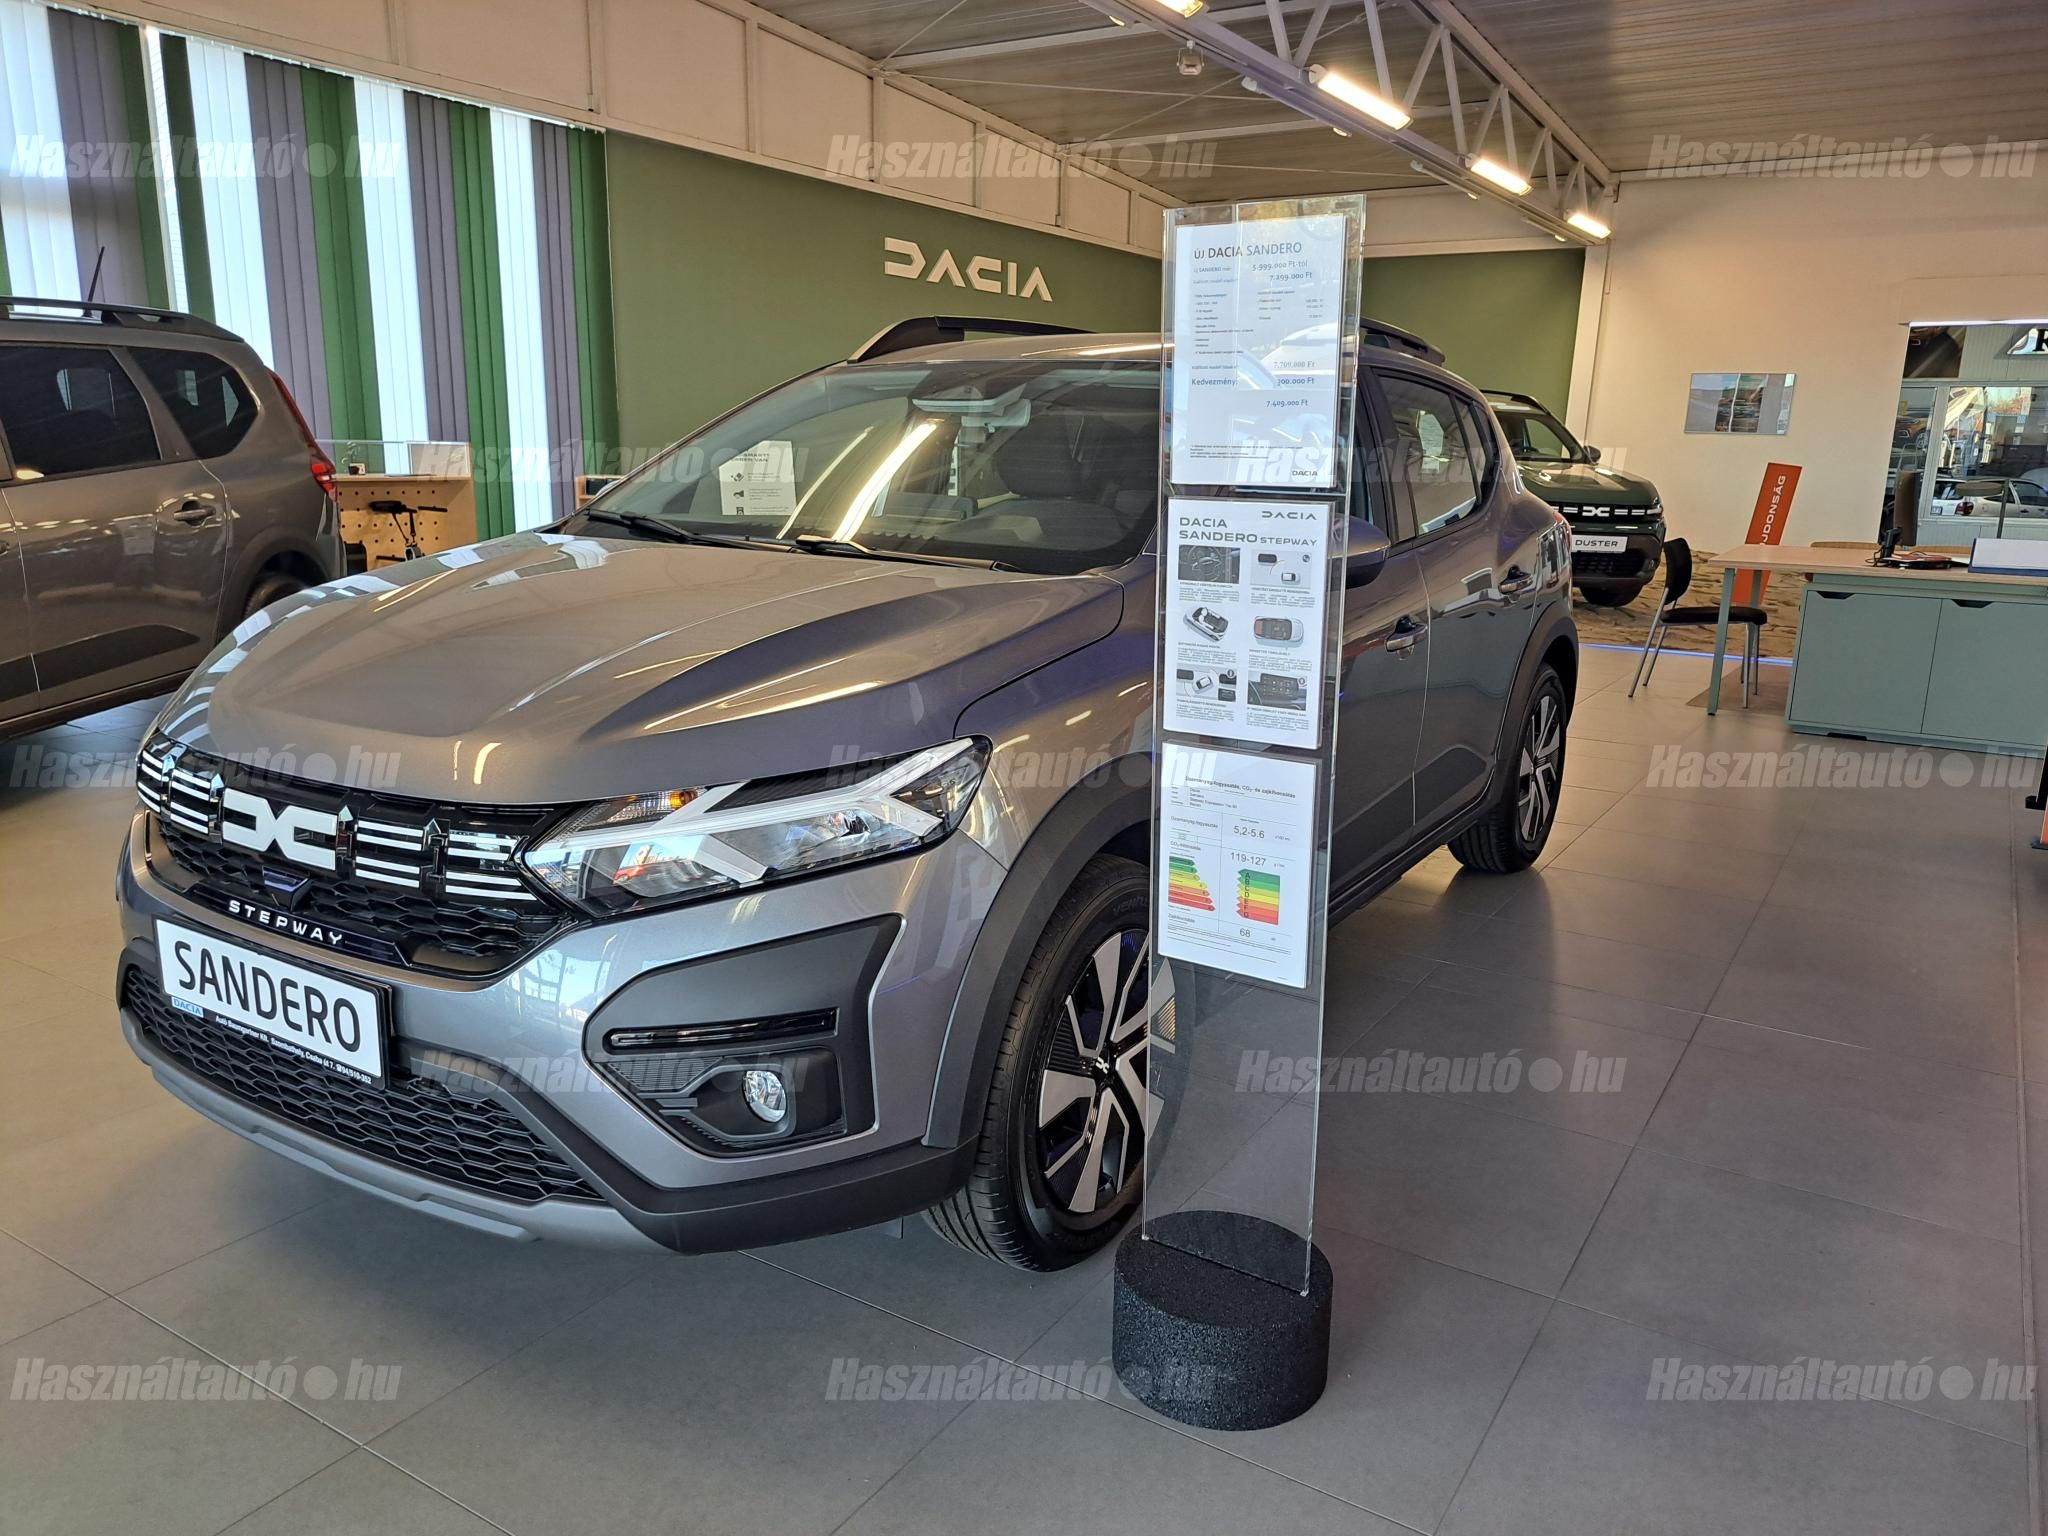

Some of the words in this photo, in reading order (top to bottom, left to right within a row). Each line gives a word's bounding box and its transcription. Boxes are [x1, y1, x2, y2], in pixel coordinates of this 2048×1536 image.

[1208, 246, 1242, 259] DACIA
[1246, 242, 1303, 257] SANDERO
[884, 237, 1053, 302] DACIA
[1305, 271, 1313, 280] Ft
[1306, 377, 1315, 385] Ft
[1261, 510, 1318, 521] DACIA
[1760, 475, 1786, 546] JDONSÁG
[1178, 517, 1228, 529] DACIA
[1179, 530, 1258, 543] SANDERO
[1260, 536, 1318, 547] STEPWAY
[1575, 539, 1618, 547] DUSTER
[1231, 852, 1266, 867] 119-127
[228, 899, 343, 945] STEPWAY
[1239, 928, 1251, 938] 68
[174, 940, 361, 1053] SANDERO
[173, 998, 202, 1016] DACIA
